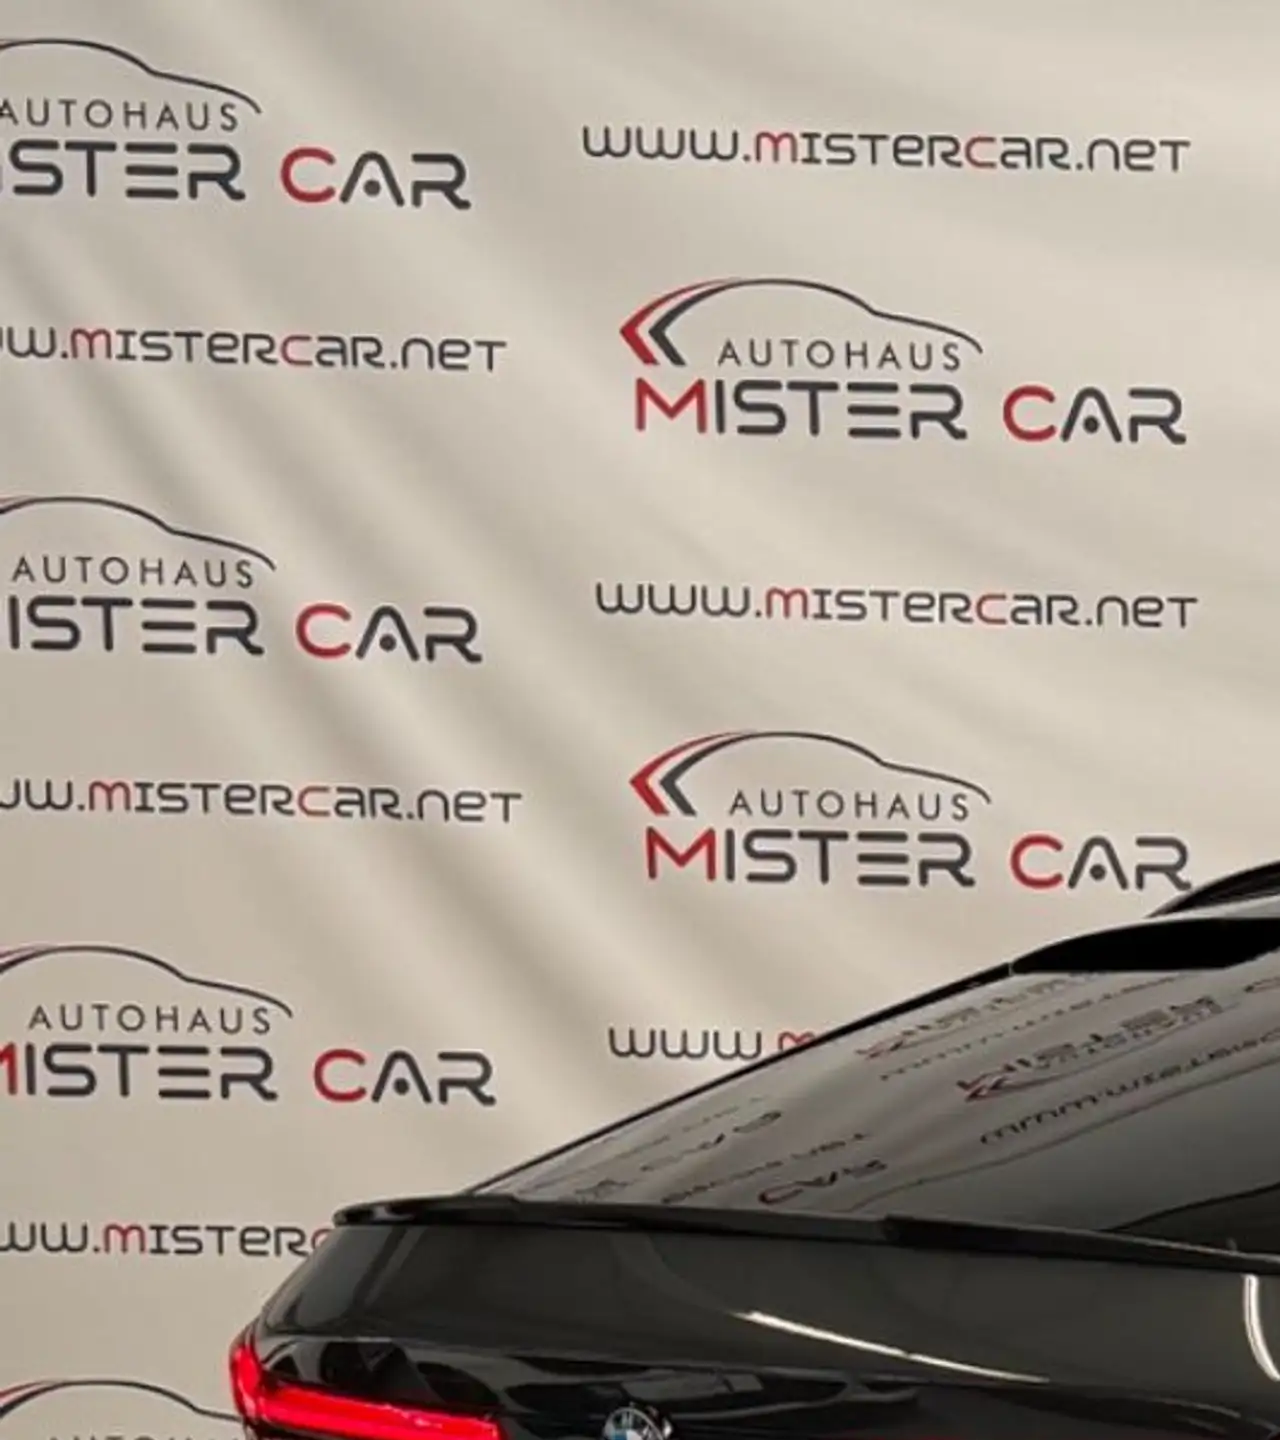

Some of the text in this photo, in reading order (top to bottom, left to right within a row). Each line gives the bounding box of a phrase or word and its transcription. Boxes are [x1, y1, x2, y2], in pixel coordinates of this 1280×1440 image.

[0, 97, 238, 131] AUTOHAUS
[9, 140, 471, 209] STER CAR
[718, 338, 961, 371] AUTOHAUS
[636, 378, 1186, 444] MISTER CAR
[12, 555, 253, 589] AUTOHAUS
[296, 604, 482, 663] CAR
[729, 788, 969, 821] AUTOHAUS
[646, 827, 1190, 890] MISTER CAR
[29, 1001, 271, 1035] AUTOHAUS
[0, 1042, 495, 1105] ISTER CAR
